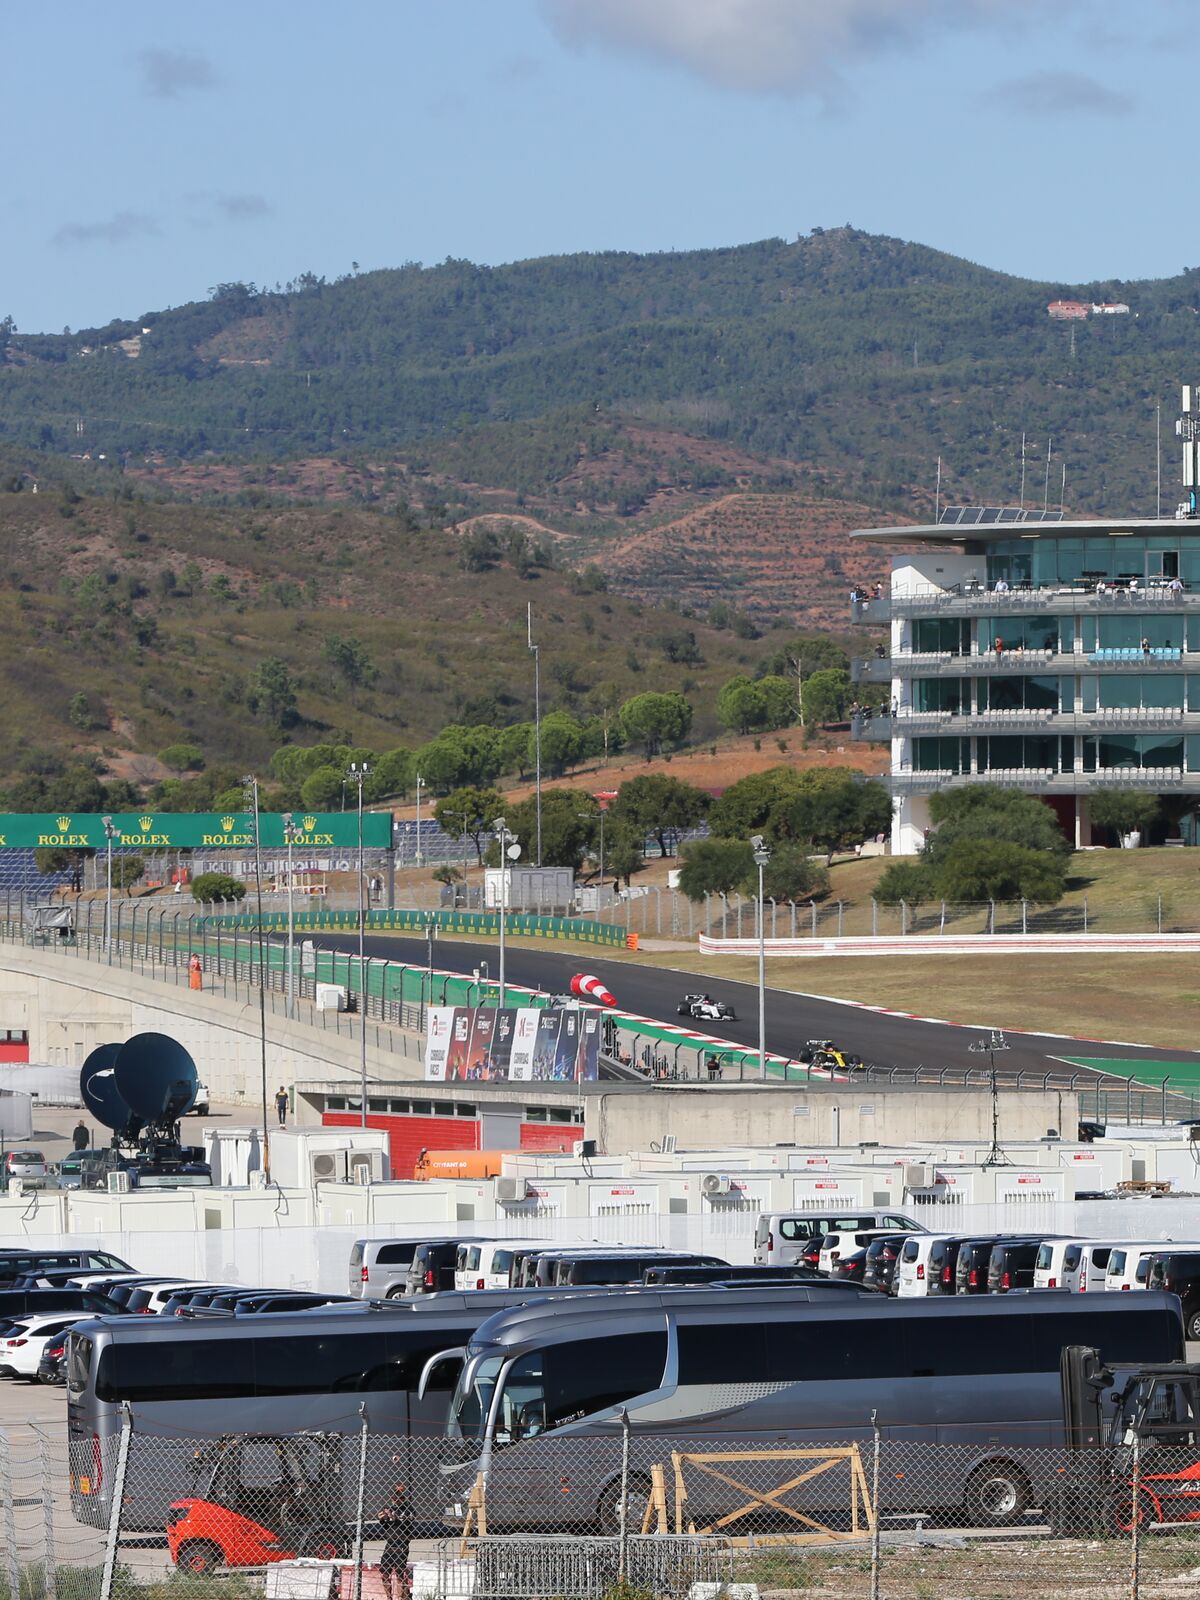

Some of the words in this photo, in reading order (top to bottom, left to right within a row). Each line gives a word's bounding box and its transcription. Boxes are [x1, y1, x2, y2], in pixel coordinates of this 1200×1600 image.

[38, 835, 89, 845] ROLEX
[121, 835, 170, 845] ROLEX
[203, 834, 253, 845] ROLEX
